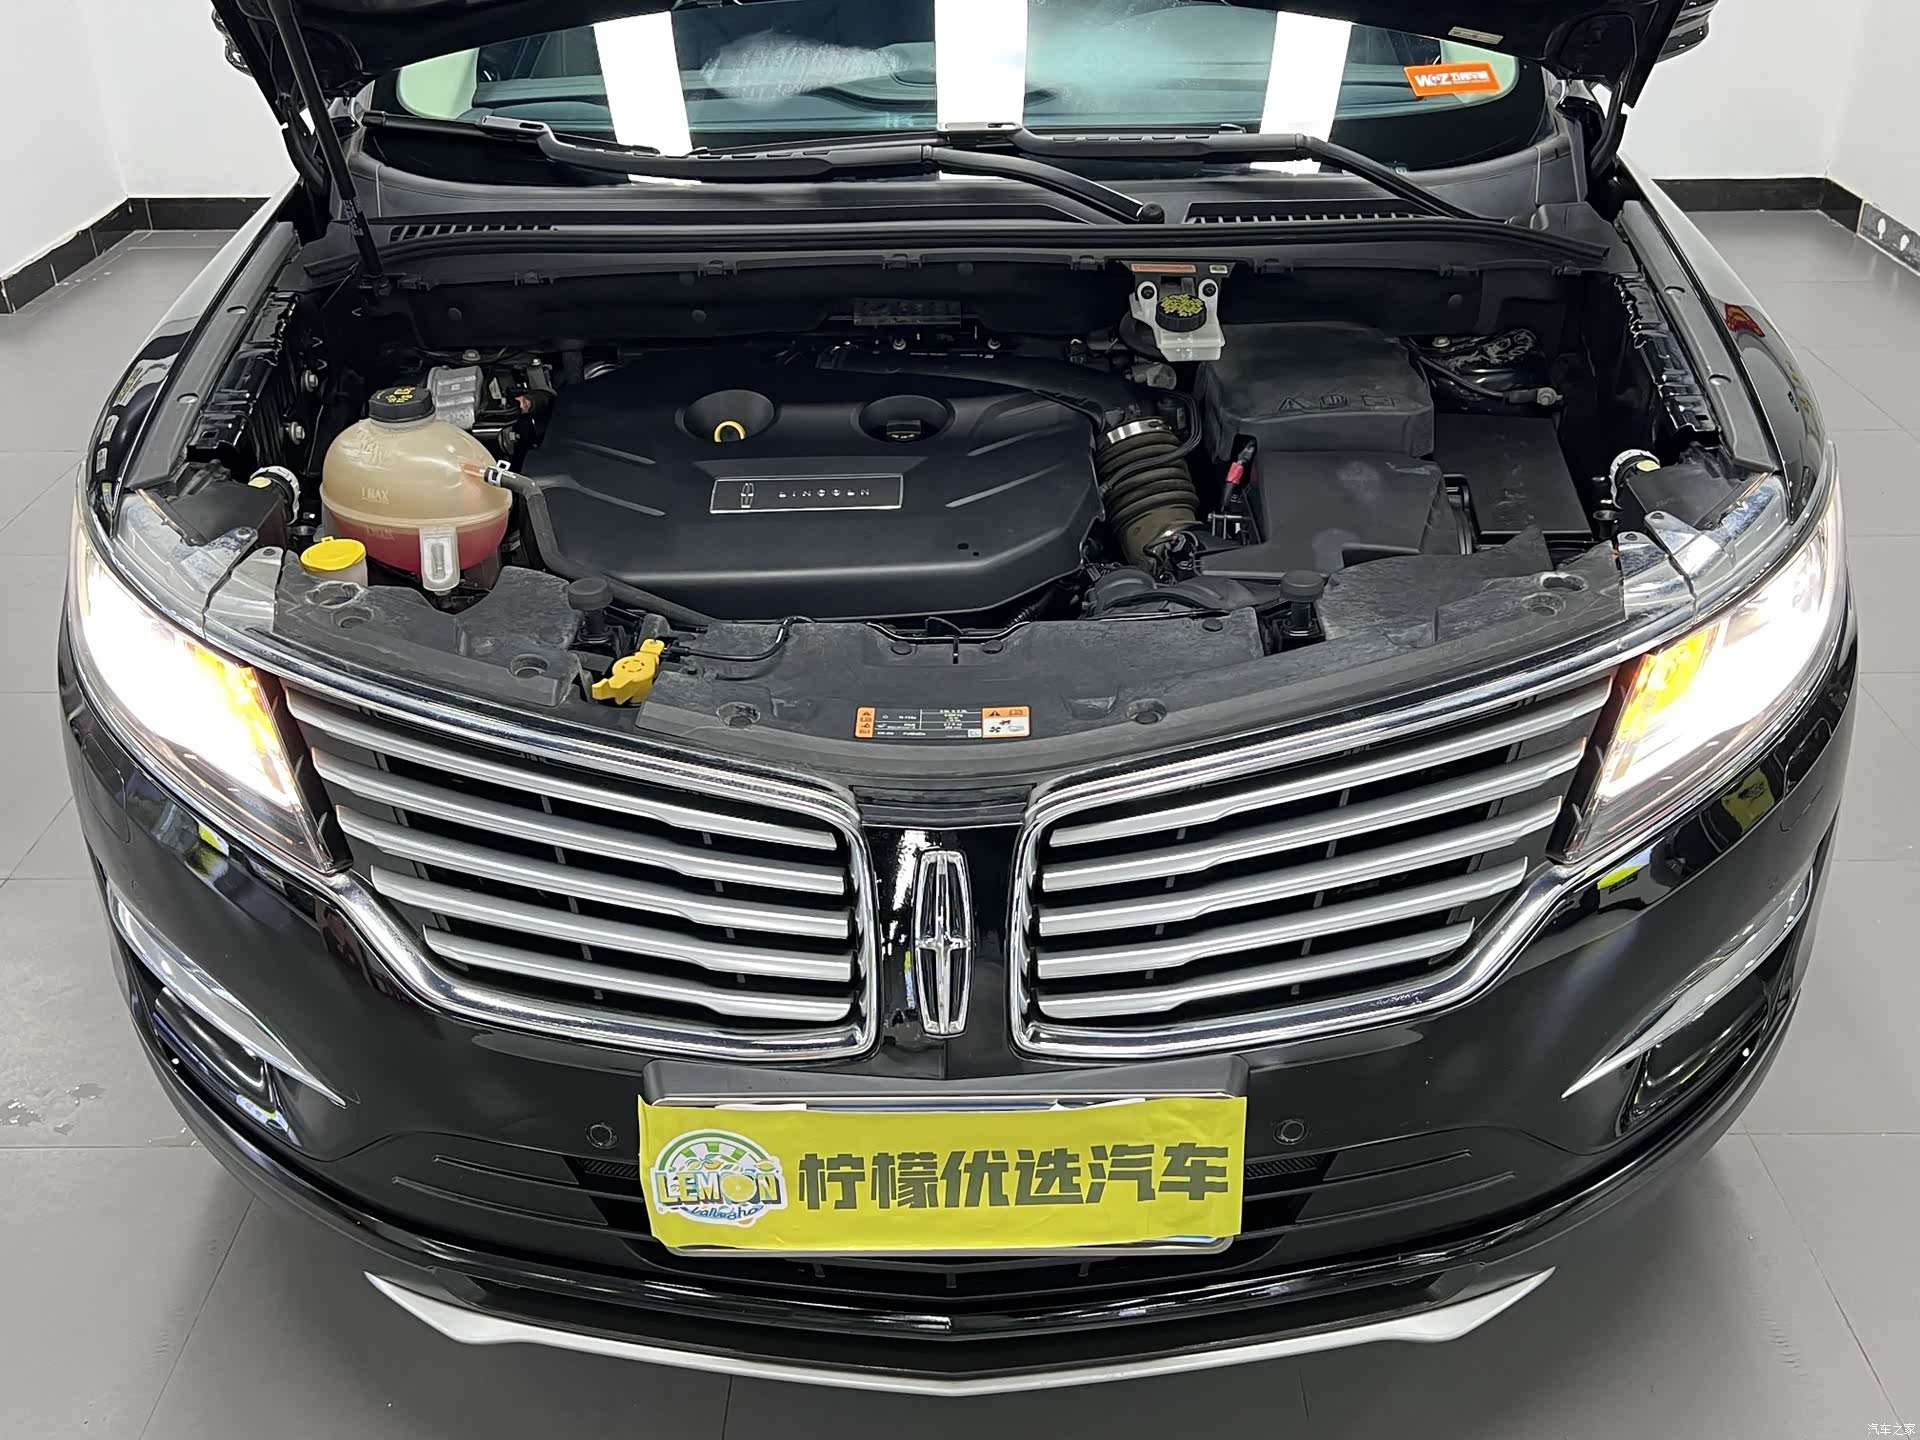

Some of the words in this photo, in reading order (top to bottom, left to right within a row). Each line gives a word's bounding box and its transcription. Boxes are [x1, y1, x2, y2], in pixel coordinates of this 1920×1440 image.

[655, 1171, 782, 1206] LEMON
[799, 1143, 1230, 1210] 柠檬优选汽车
